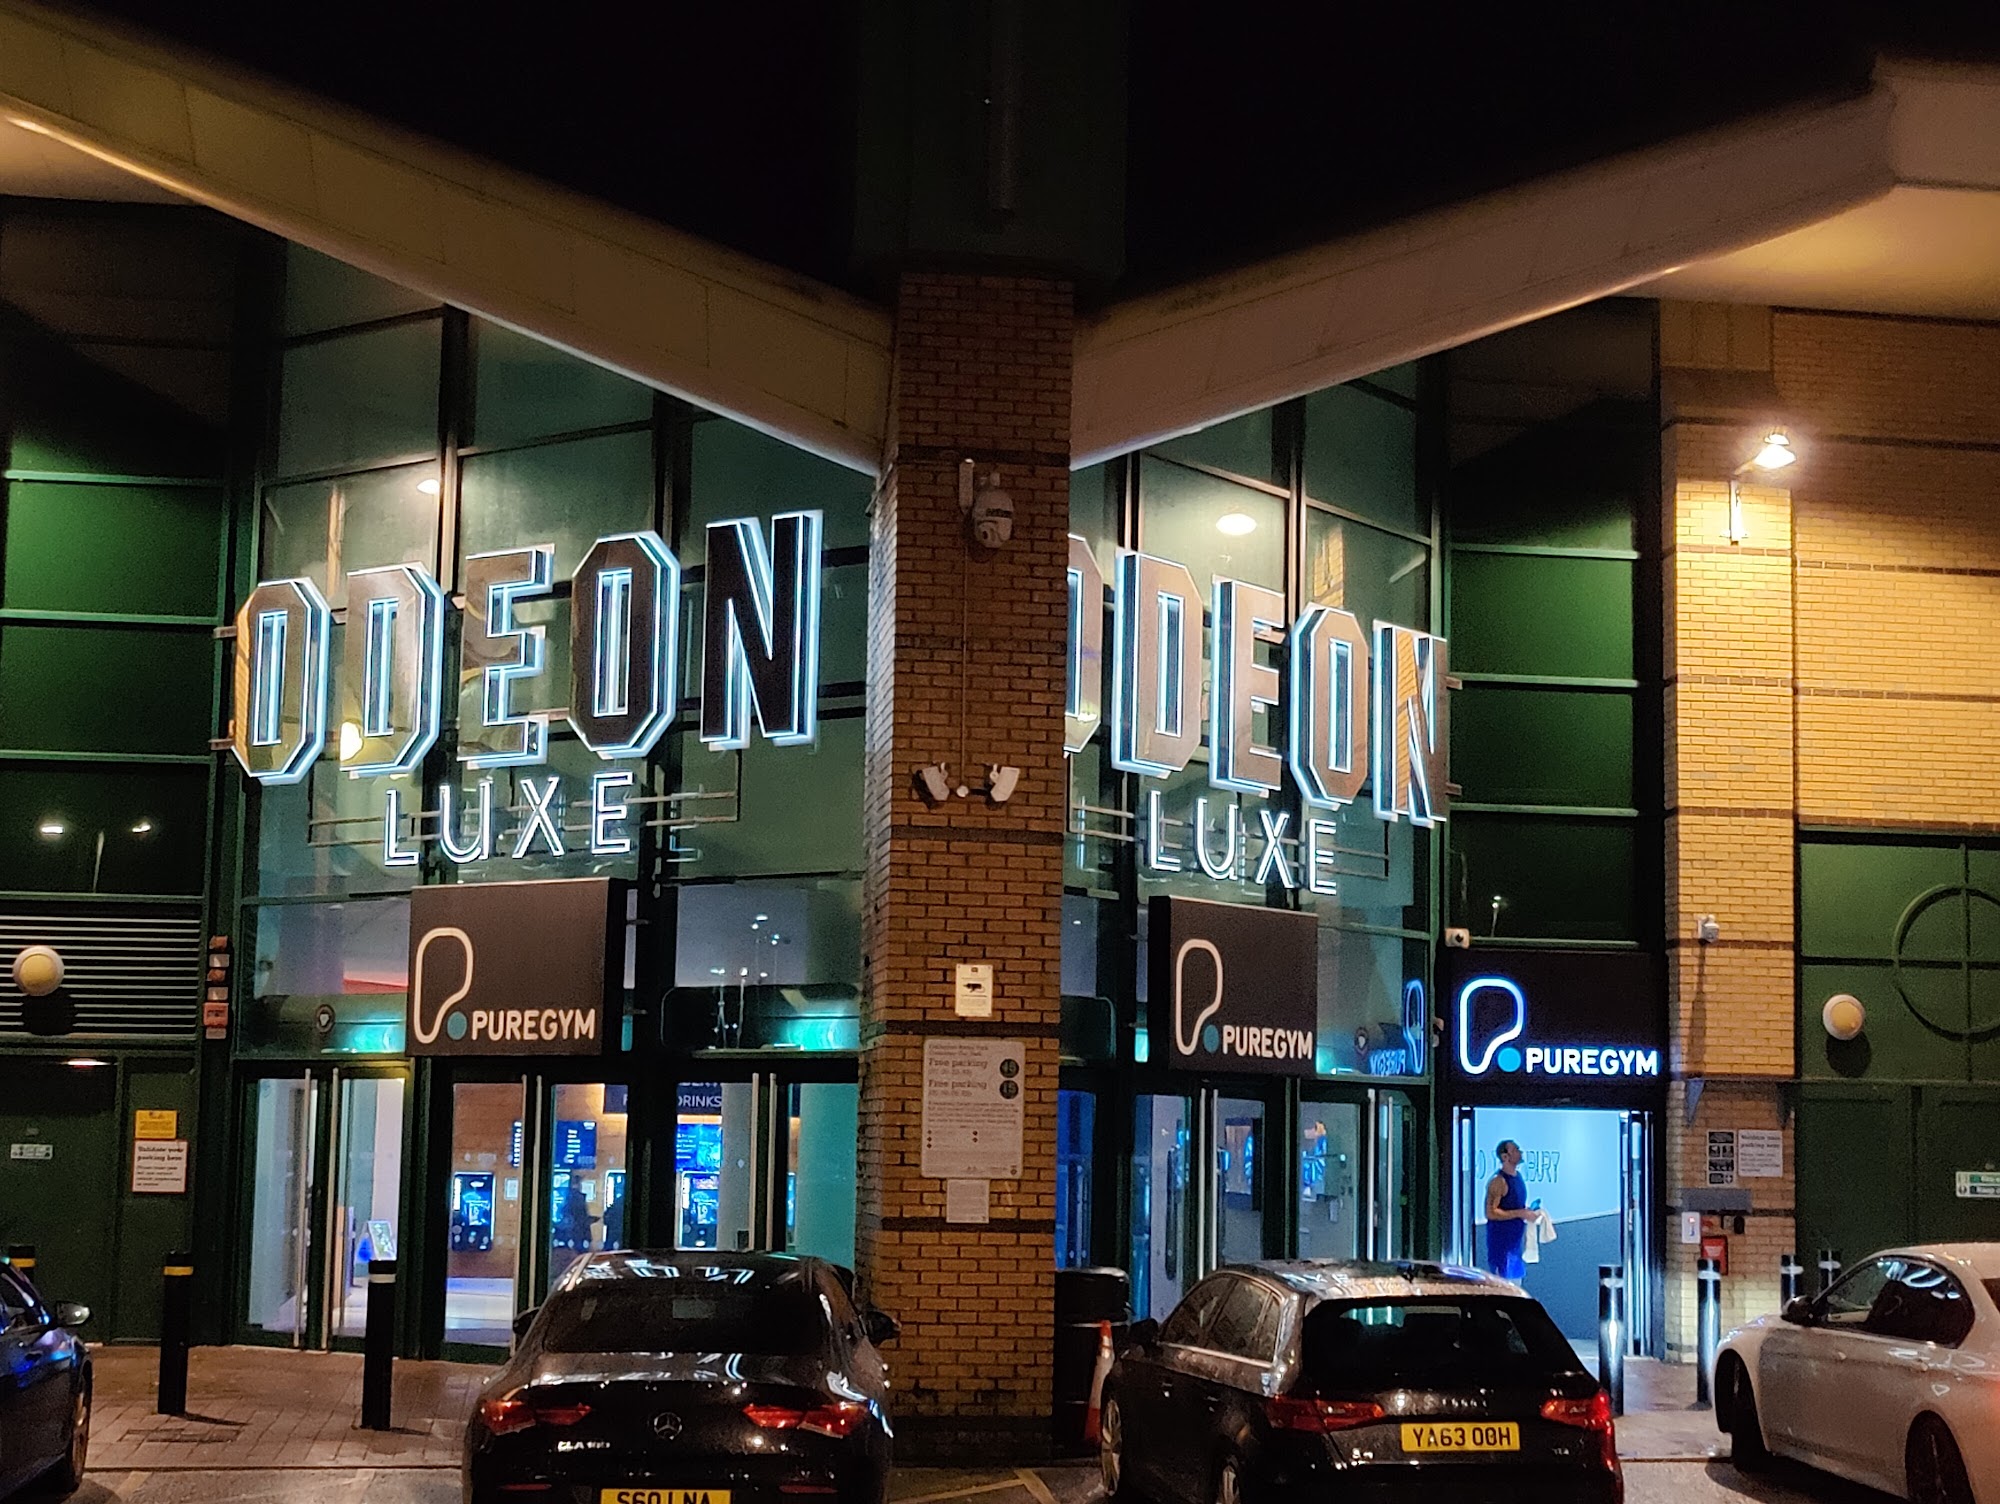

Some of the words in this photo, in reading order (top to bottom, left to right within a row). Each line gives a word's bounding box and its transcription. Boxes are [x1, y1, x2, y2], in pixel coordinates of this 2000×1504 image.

[230, 510, 823, 785] ODEON
[384, 771, 633, 865] LUXE
[1147, 791, 1338, 896] LUXE
[471, 1008, 596, 1041] PUREGYM
[1222, 1025, 1313, 1060] PUREGYM
[1525, 1047, 1659, 1076] PUREGYM
[1413, 1426, 1466, 1447] YA63
